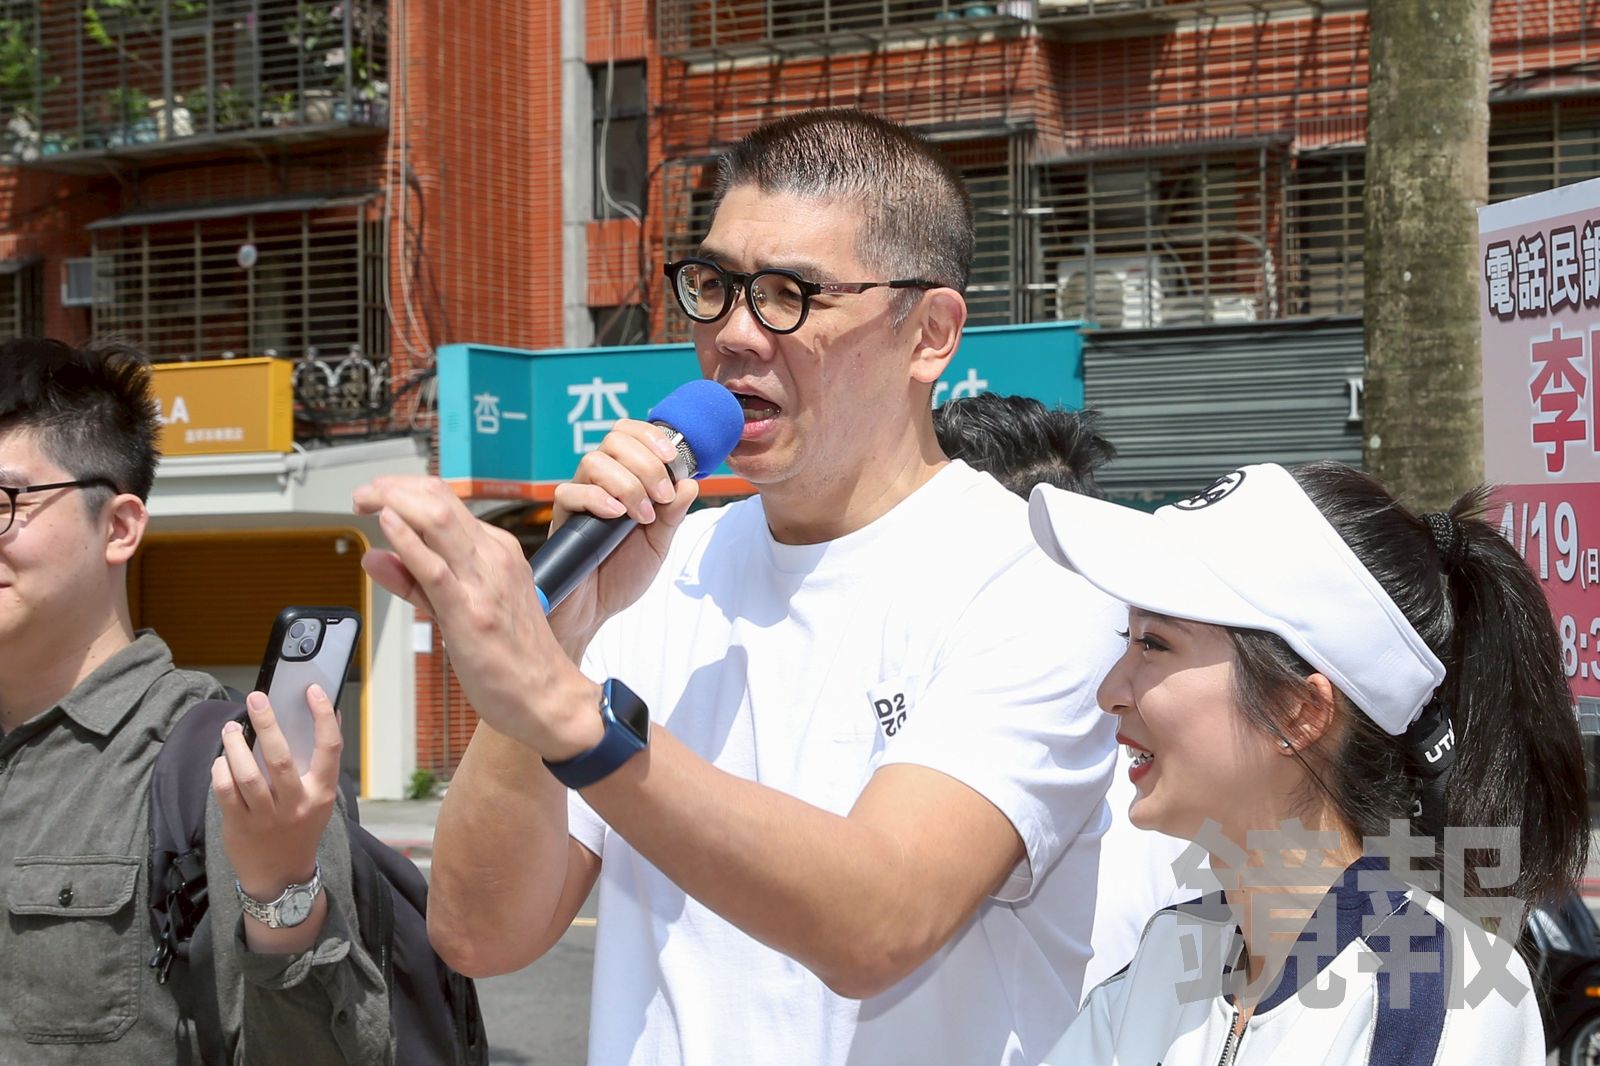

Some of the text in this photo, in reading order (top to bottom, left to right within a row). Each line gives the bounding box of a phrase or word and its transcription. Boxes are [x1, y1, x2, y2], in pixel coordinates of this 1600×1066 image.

[474, 392, 527, 434] 杏一
[567, 377, 653, 454] 杏
[1530, 326, 1600, 474] 李
